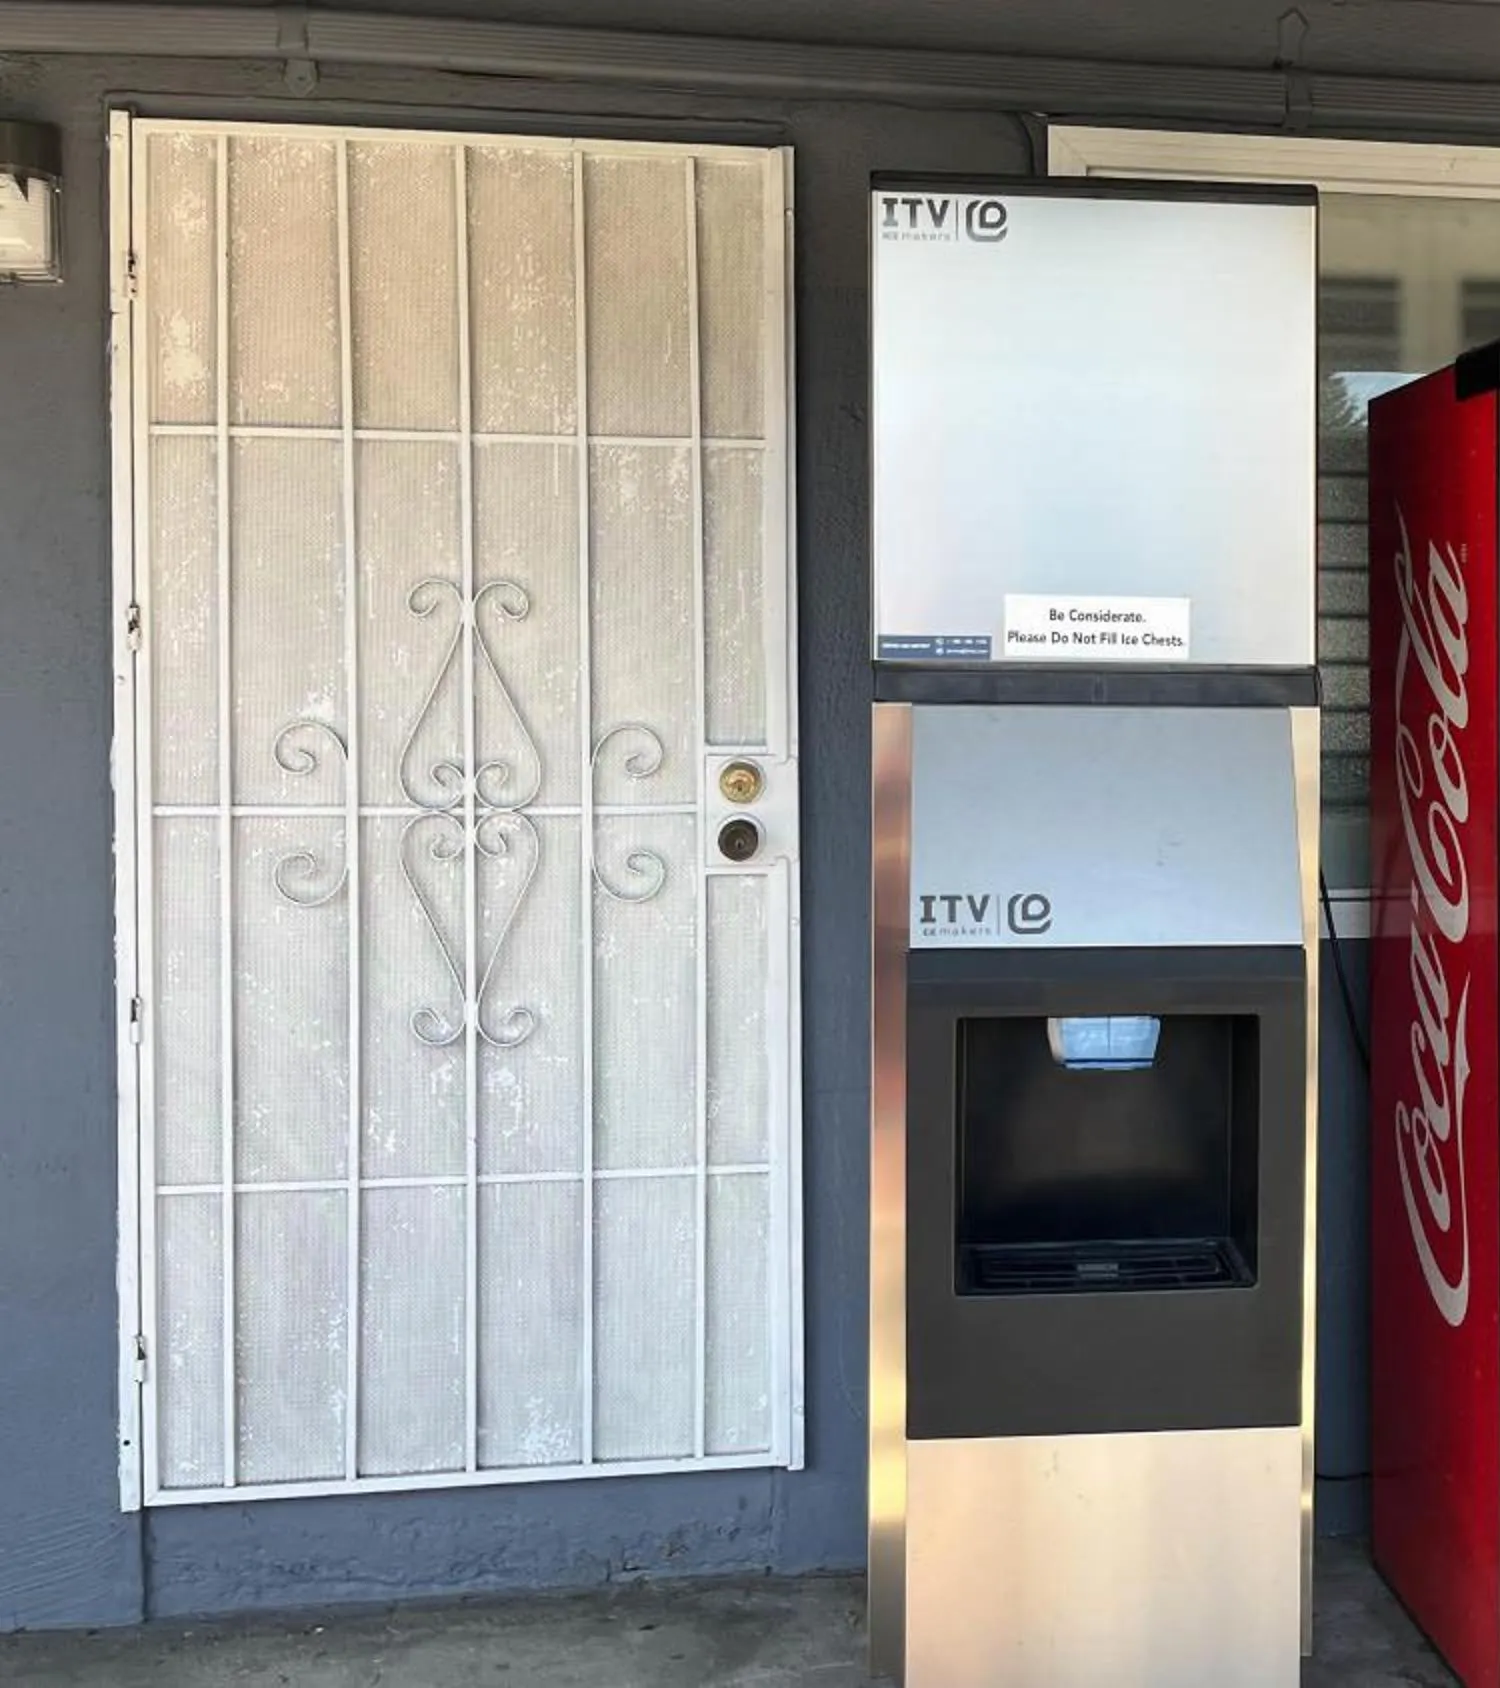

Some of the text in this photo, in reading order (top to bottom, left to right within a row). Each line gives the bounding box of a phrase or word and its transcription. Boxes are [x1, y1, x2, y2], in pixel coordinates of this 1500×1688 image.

[882, 197, 951, 229] ITV
[1049, 608, 1147, 623] Be Considerate.
[1007, 630, 1047, 643] Please
[1051, 631, 1069, 644] Do
[1072, 632, 1096, 645] Not
[1099, 632, 1117, 645] Fill
[1121, 633, 1139, 645] Ice
[919, 895, 990, 923] ITV
[1394, 499, 1470, 1326] Coca-Cola
